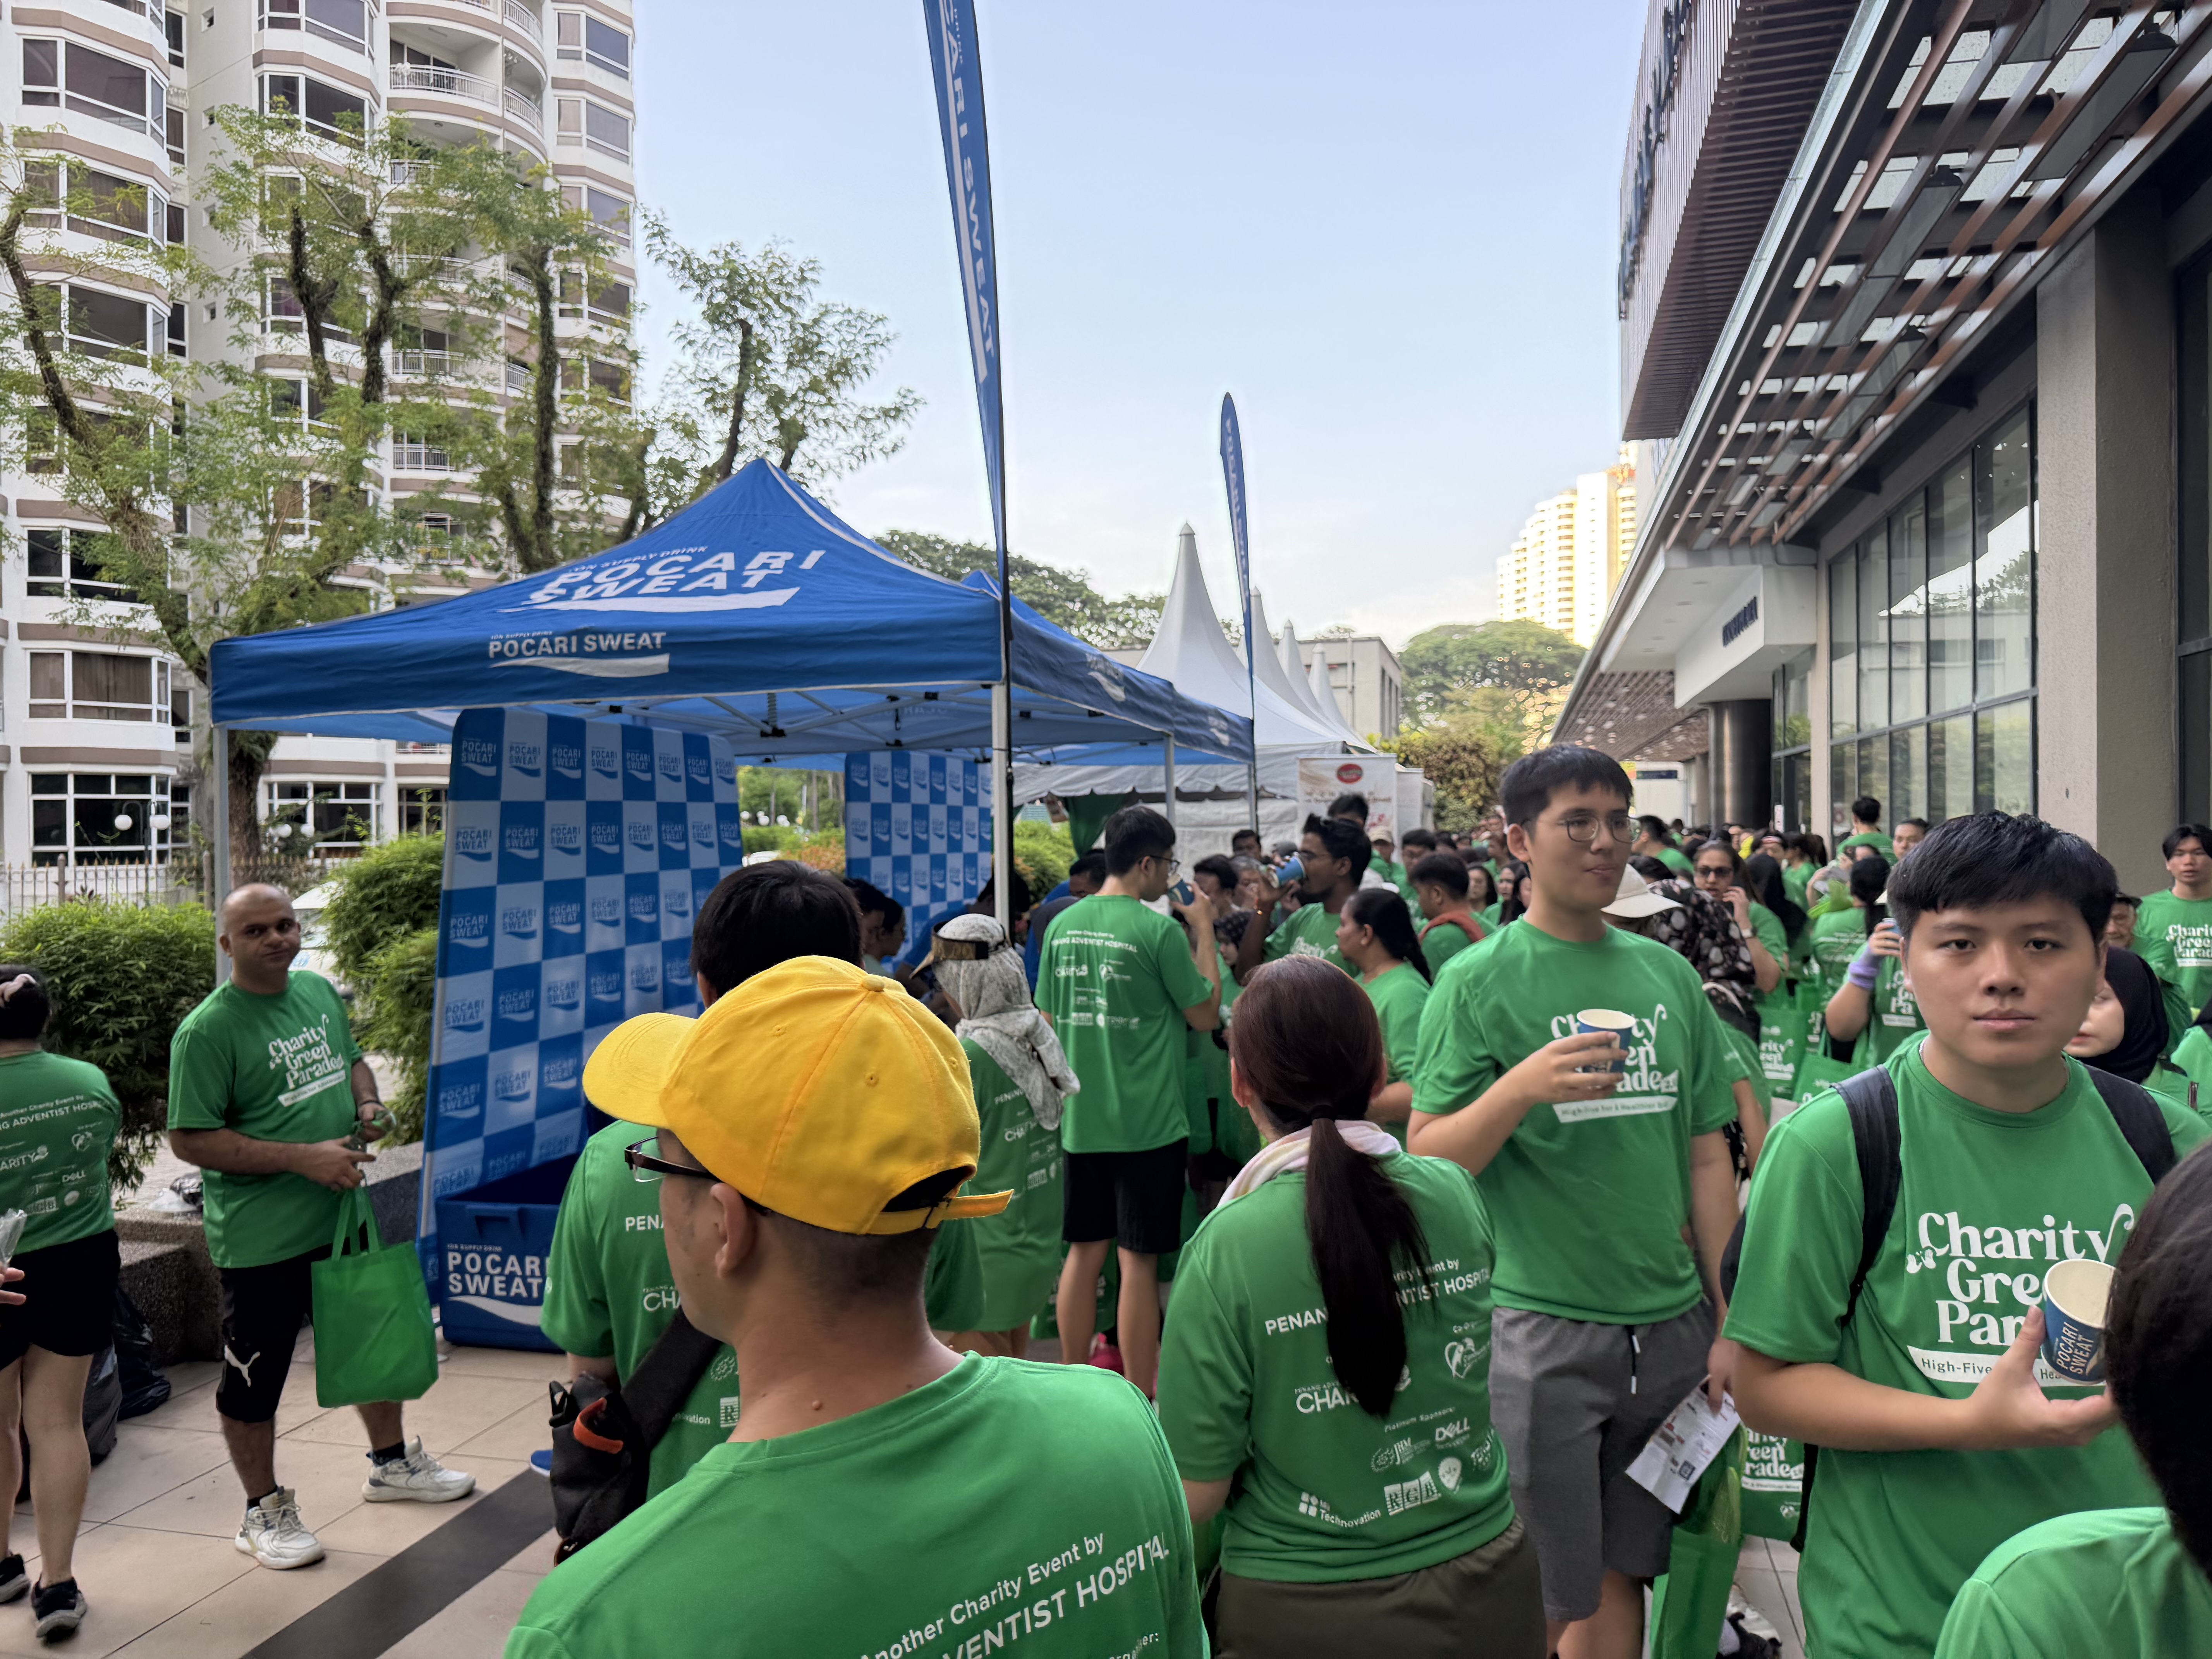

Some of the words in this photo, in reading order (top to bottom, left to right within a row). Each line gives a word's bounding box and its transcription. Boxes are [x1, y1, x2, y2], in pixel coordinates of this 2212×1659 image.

[543, 550, 826, 590] POCARI
[521, 570, 783, 605] SWEAT
[489, 635, 577, 658] POCARI
[584, 632, 666, 652] SWEAT
[462, 740, 496, 754] POCARI
[462, 752, 493, 763] SWEAT
[269, 1013, 329, 1057] Charity
[285, 1040, 331, 1070] Green
[12, 1106, 70, 1127] ADVENTIST
[1918, 1203, 2135, 1263] Charity
[1446, 1259, 1459, 1271] by
[448, 1273, 543, 1298] SWEAT
[1947, 1258, 2046, 1306] Gre
[1265, 1308, 1329, 1335] PENAN
[1936, 1300, 2026, 1346] Par
[2056, 1322, 2078, 1370] POCARI
[2069, 1334, 2094, 1375] SWEAT
[1922, 1358, 1992, 1374] High-Five
[1435, 1417, 1470, 1441] DELL
[1320, 1509, 1381, 1528] Technovation
[861, 1618, 944, 1659] nother
[950, 1576, 1022, 1625] Charity
[1027, 1544, 1081, 1585] Event
[1084, 1533, 1103, 1555] by
